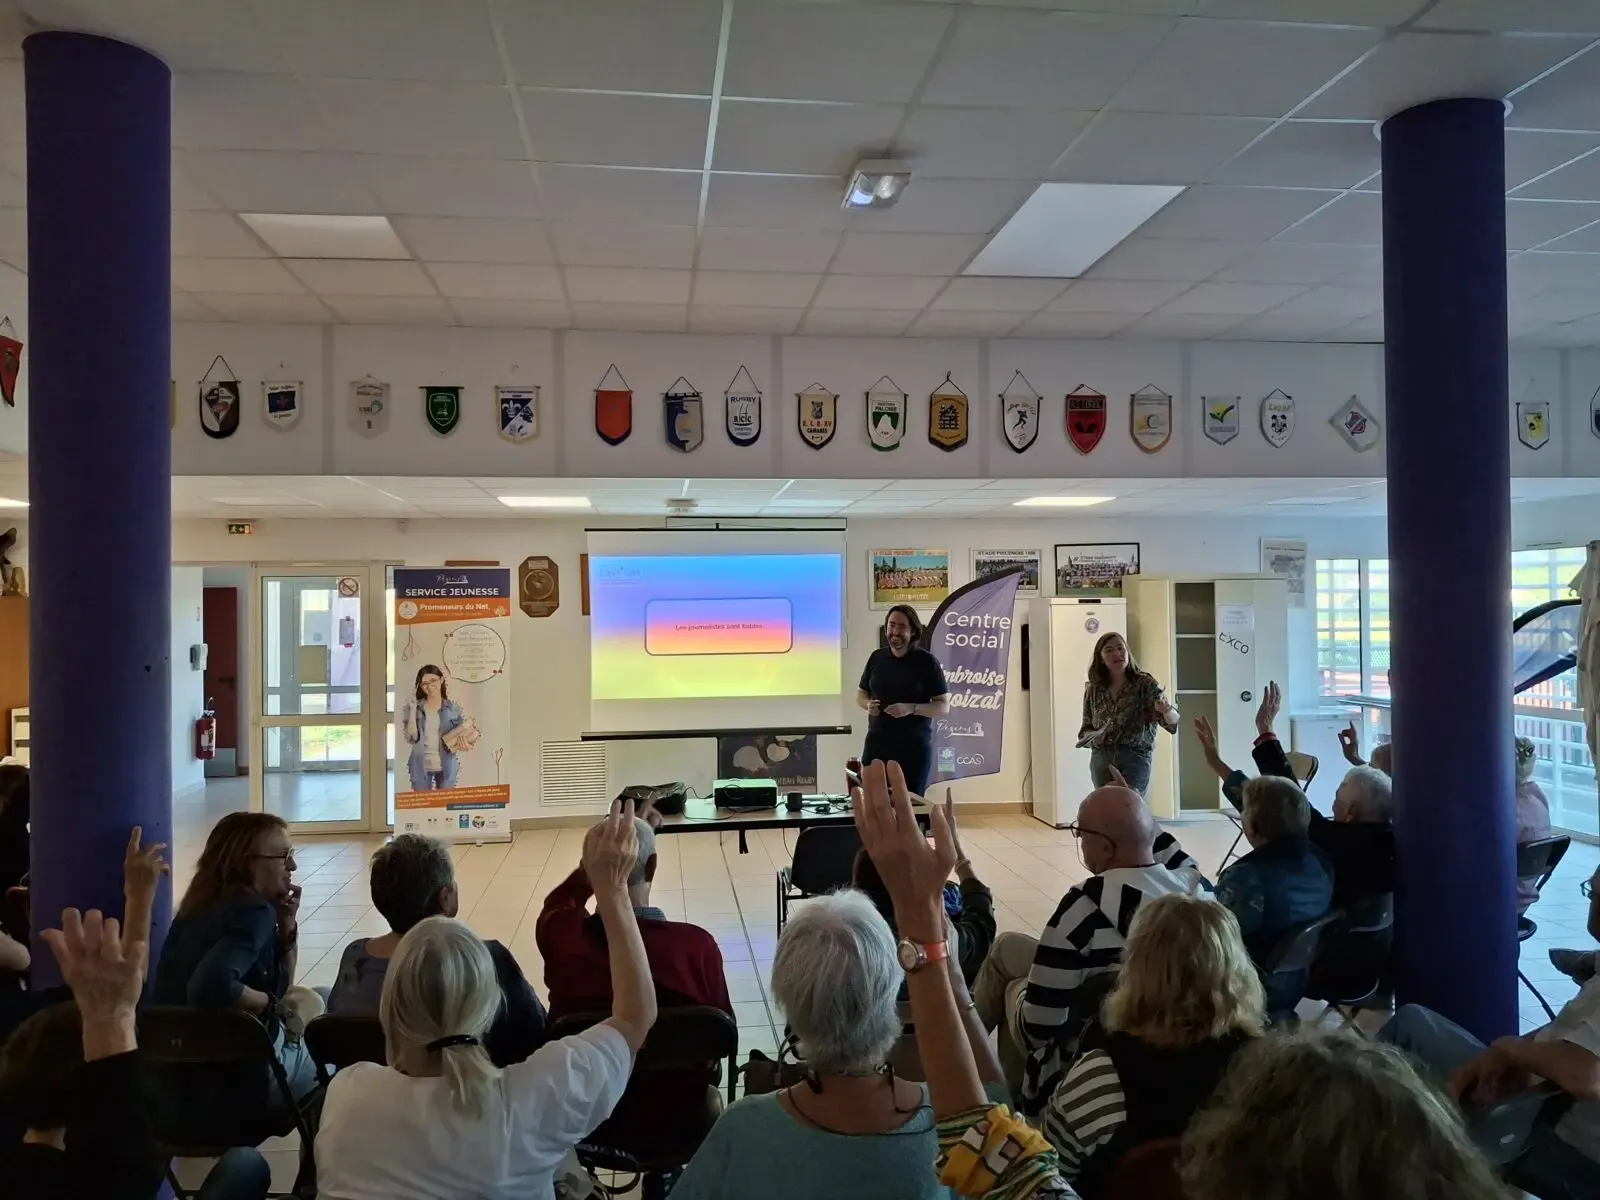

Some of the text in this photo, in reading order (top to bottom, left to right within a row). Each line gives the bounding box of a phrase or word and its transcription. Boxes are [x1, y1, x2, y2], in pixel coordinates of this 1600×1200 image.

[730, 396, 757, 404] RUGBY
[405, 588, 500, 597] SERVICE JEUNESSE
[419, 603, 464, 611] Promeneurs
[944, 611, 1011, 629] Centre
[688, 624, 725, 632] journalistes
[944, 630, 1005, 649] social
[1218, 632, 1249, 654] EXCO
[940, 664, 1006, 687] mbroise
[945, 688, 1004, 710] oizat
[956, 756, 982, 765] CCAS
